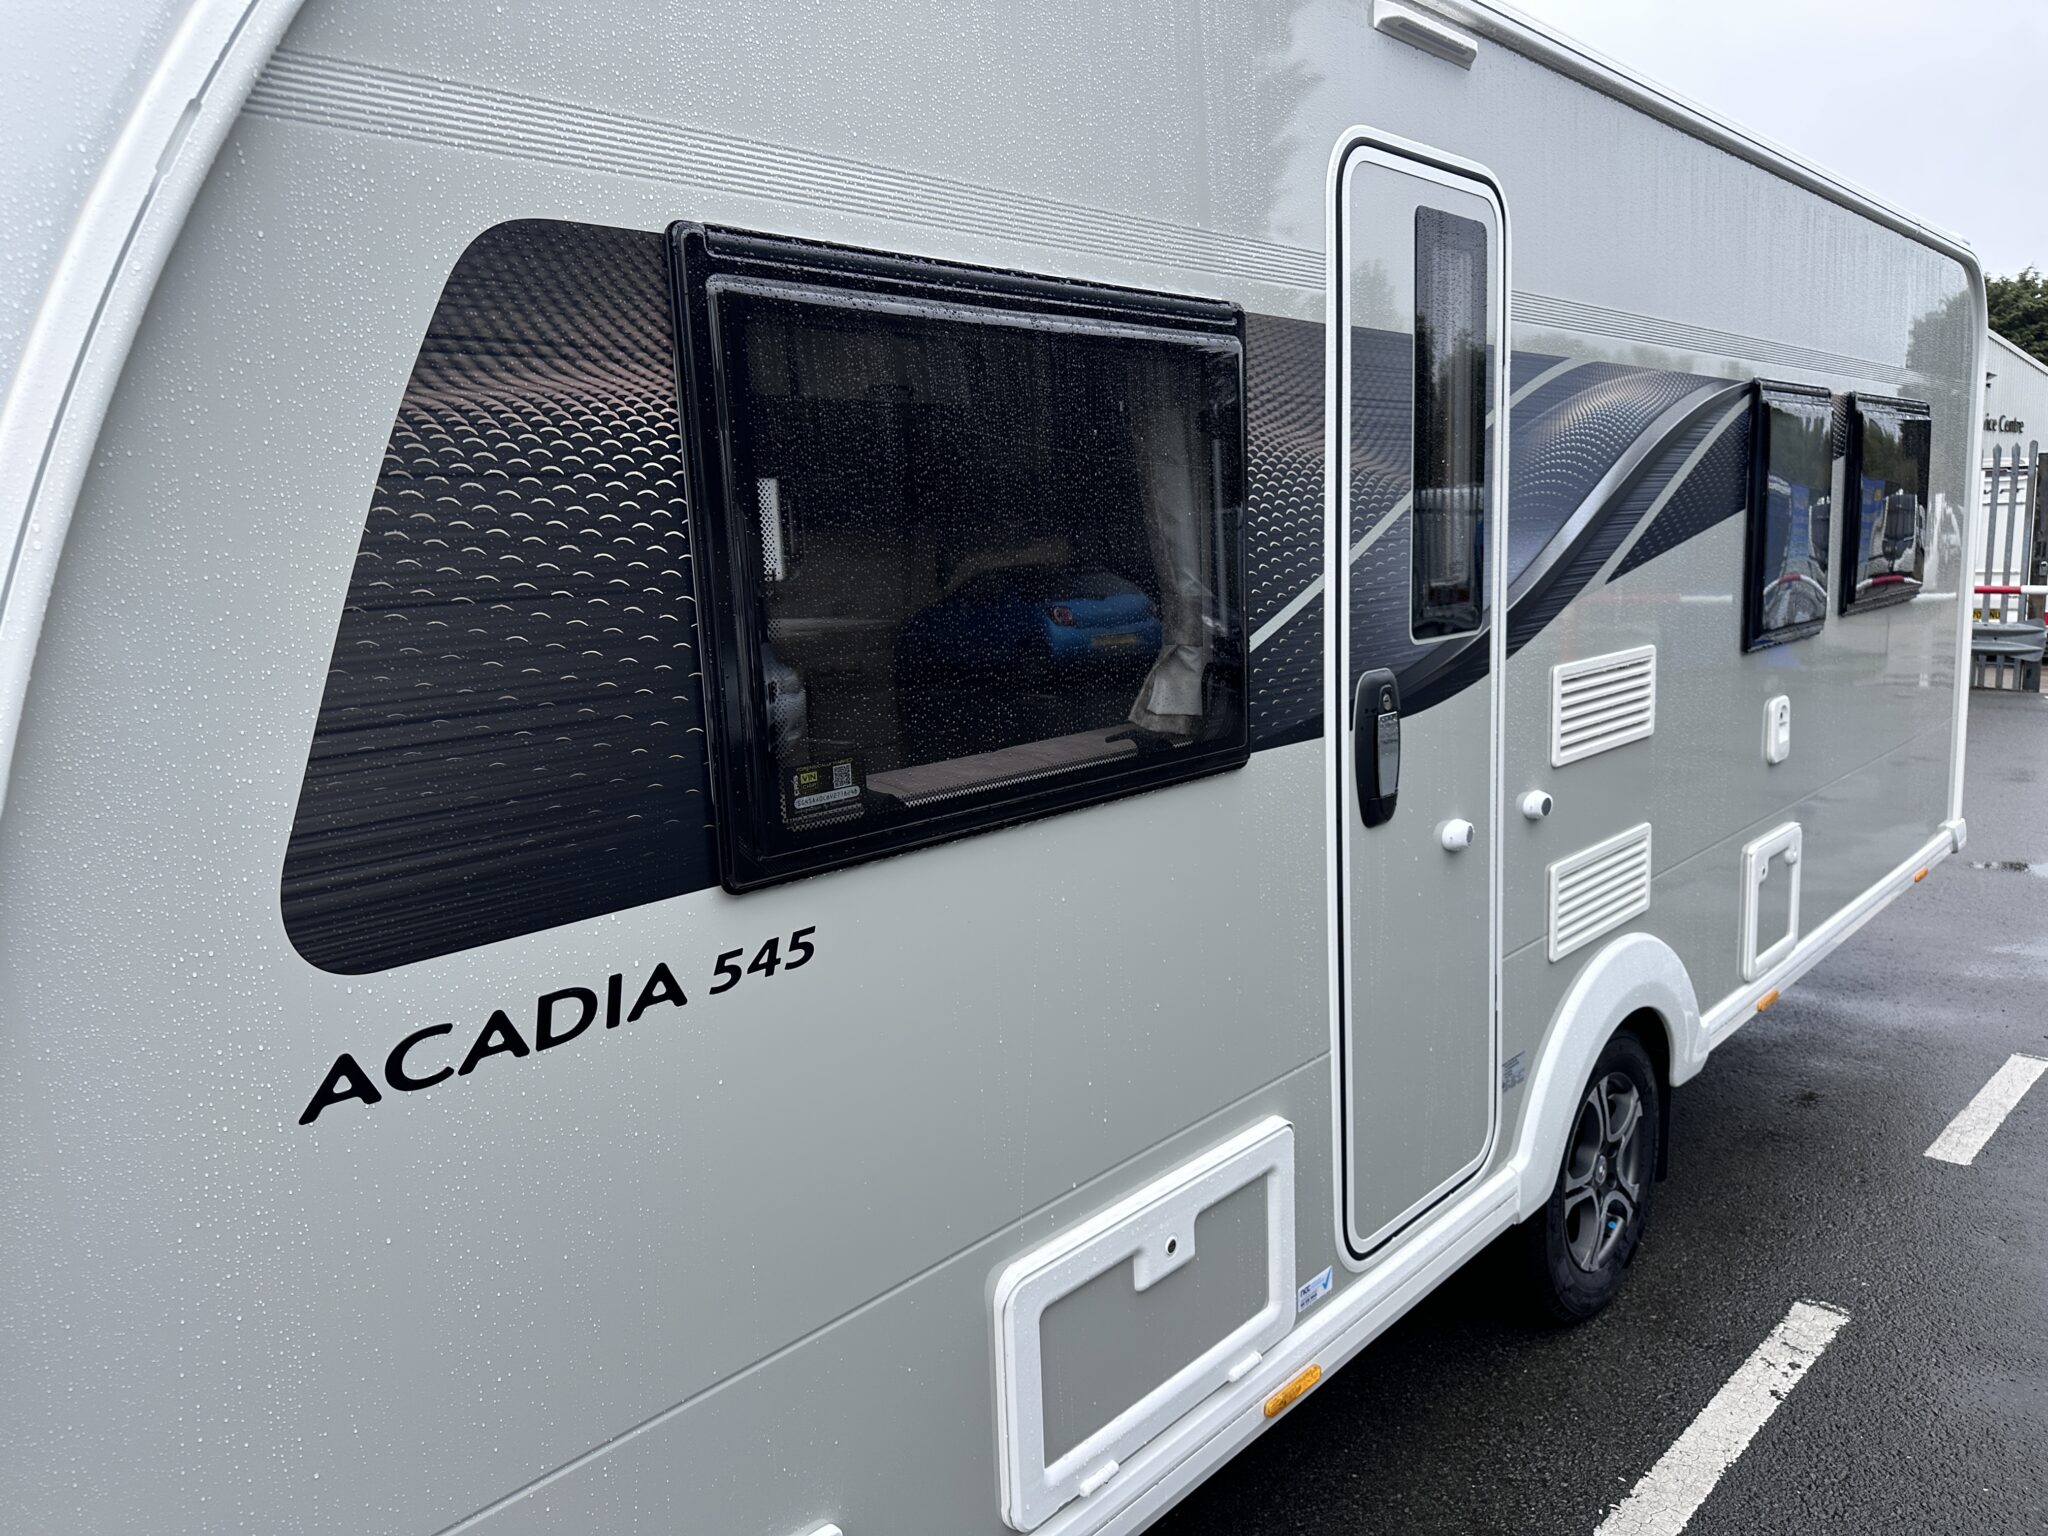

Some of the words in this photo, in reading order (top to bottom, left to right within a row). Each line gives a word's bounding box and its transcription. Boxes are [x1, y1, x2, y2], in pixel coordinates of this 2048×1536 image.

[1999, 414, 2024, 434] Centre
[802, 773, 816, 782] VIN
[299, 963, 687, 1125] ACADIA
[710, 926, 816, 995] 545
